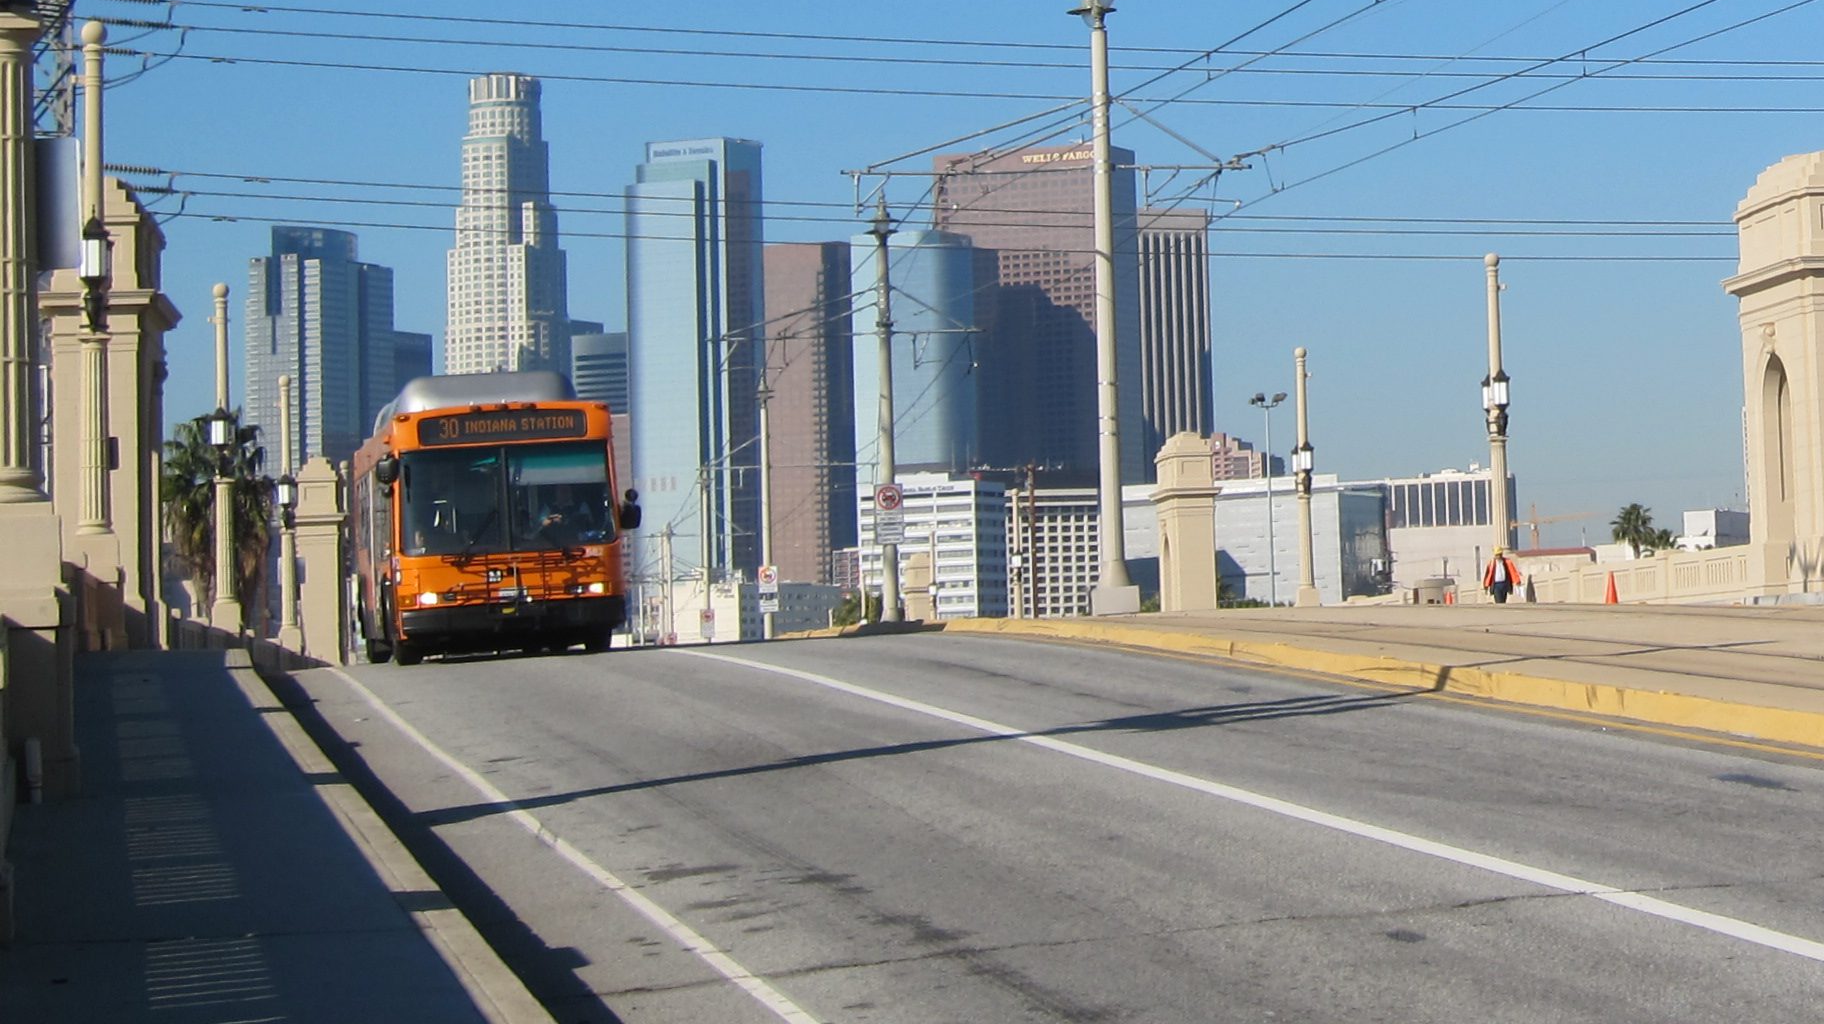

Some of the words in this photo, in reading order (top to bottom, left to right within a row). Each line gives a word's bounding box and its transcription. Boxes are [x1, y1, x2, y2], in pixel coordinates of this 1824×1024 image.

[439, 418, 459, 439] 30
[465, 419, 517, 434] INDIANA
[521, 416, 574, 430] STATION
